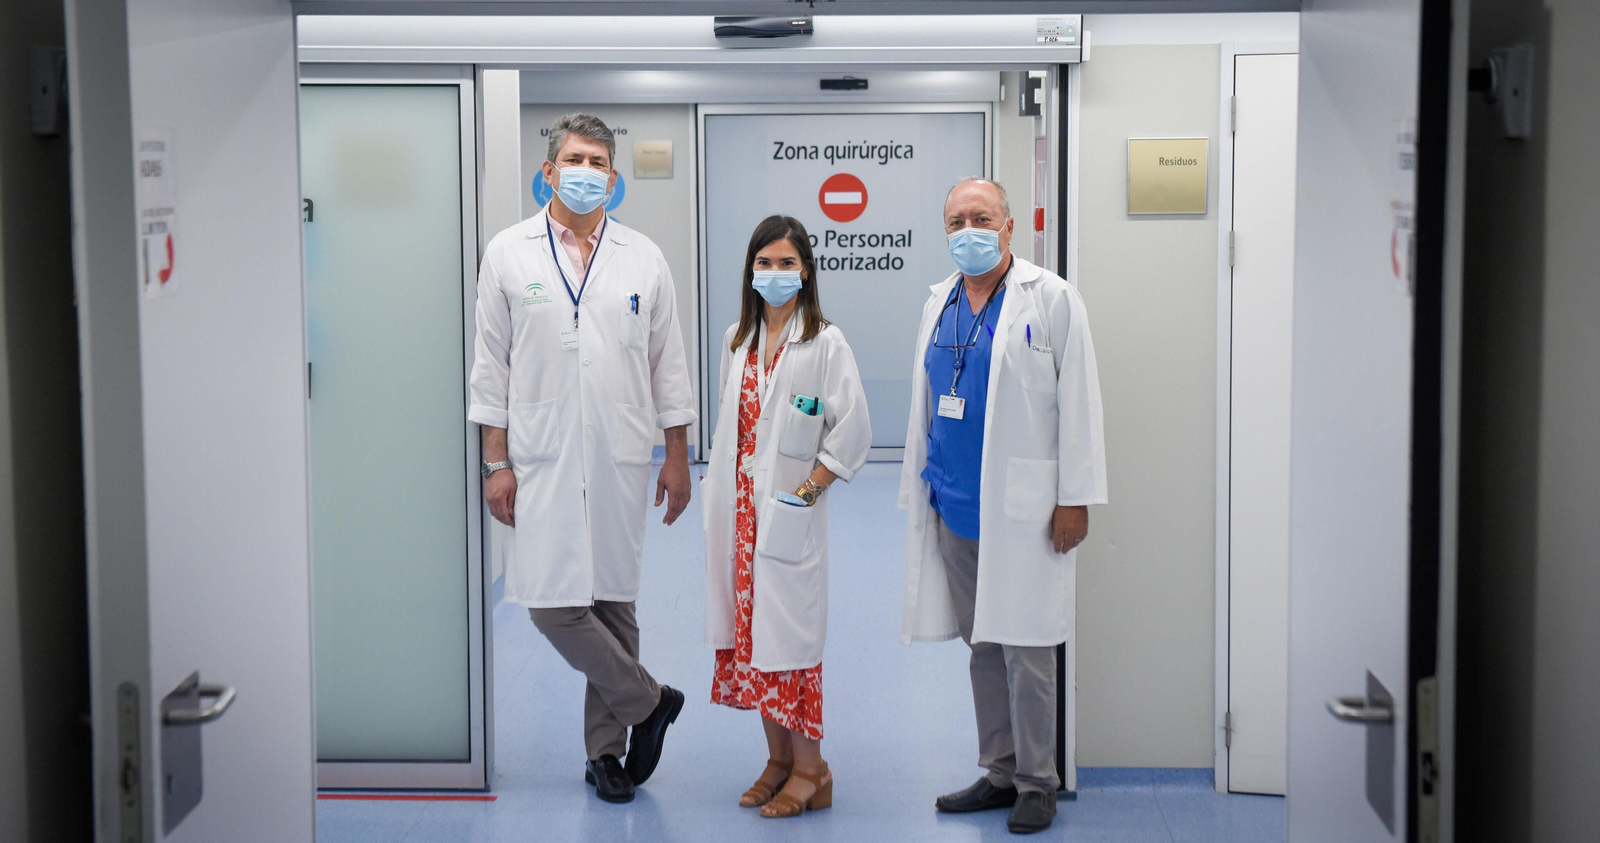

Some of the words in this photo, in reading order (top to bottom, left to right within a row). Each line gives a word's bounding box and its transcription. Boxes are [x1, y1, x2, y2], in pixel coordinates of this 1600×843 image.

[773, 141, 819, 160] Zona
[823, 140, 914, 166] quirúrgica
[1158, 156, 1198, 166] Residuos
[824, 229, 912, 248] Personal
[814, 252, 904, 271] torizado
